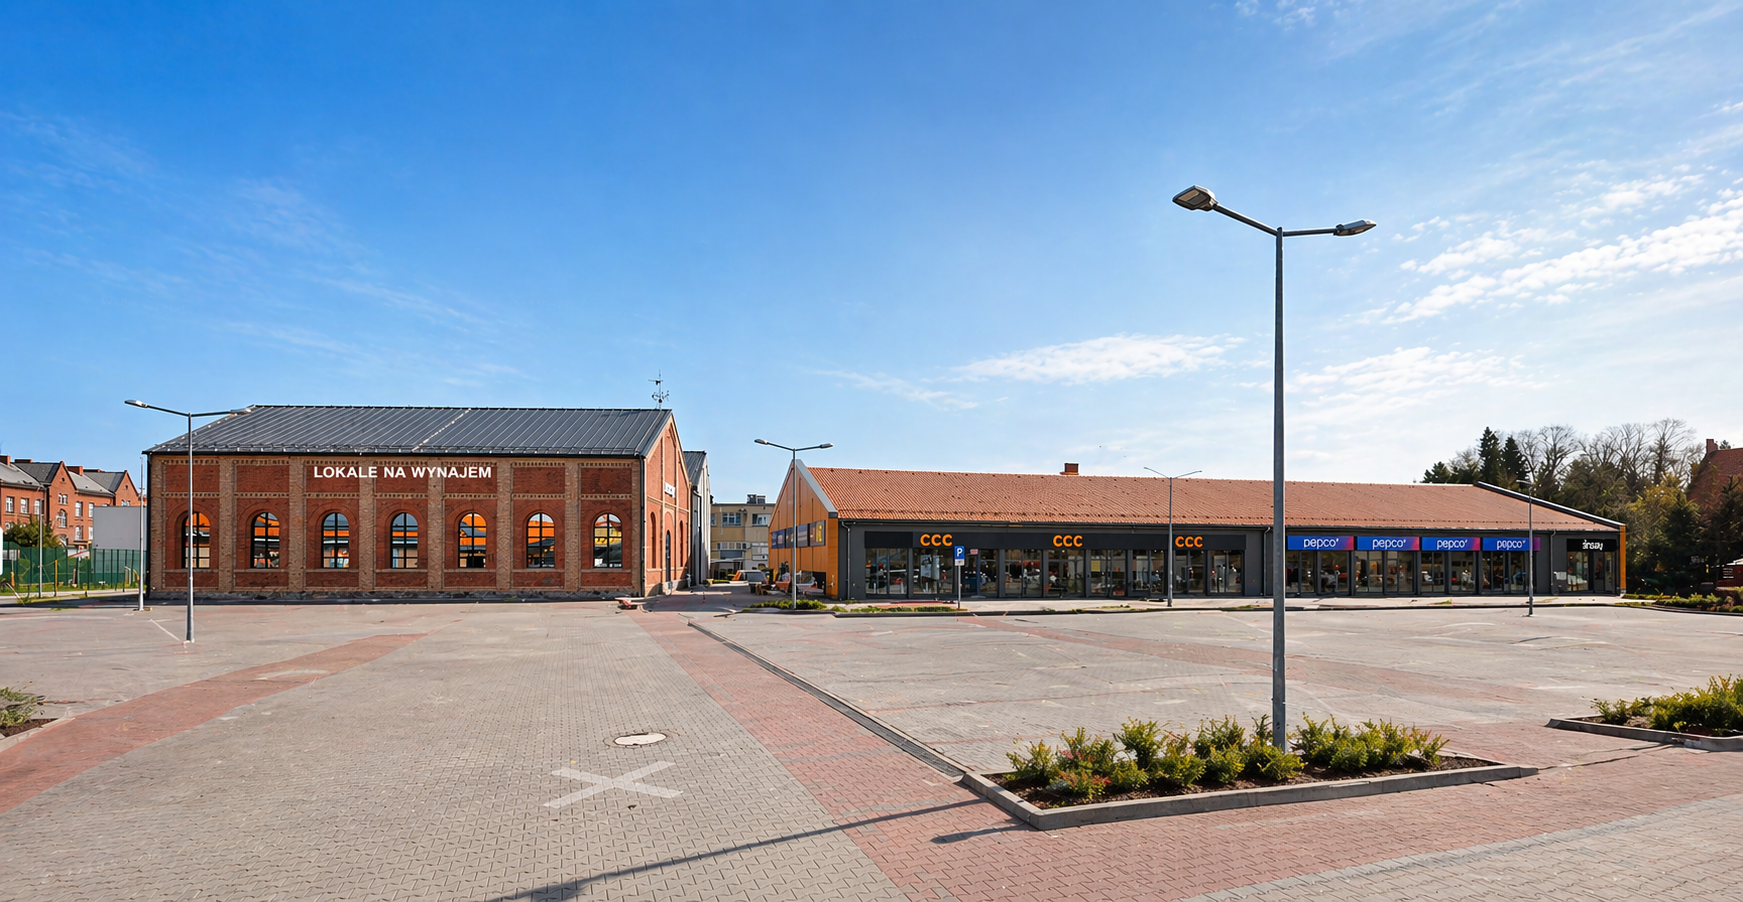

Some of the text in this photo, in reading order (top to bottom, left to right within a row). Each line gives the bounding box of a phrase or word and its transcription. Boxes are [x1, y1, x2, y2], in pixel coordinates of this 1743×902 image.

[314, 466, 492, 478] LOKALE NA WYNAJEM
[920, 533, 953, 547] CCC
[1052, 534, 1083, 548] CCC
[1174, 535, 1204, 548] CCC
[956, 547, 963, 558] P
